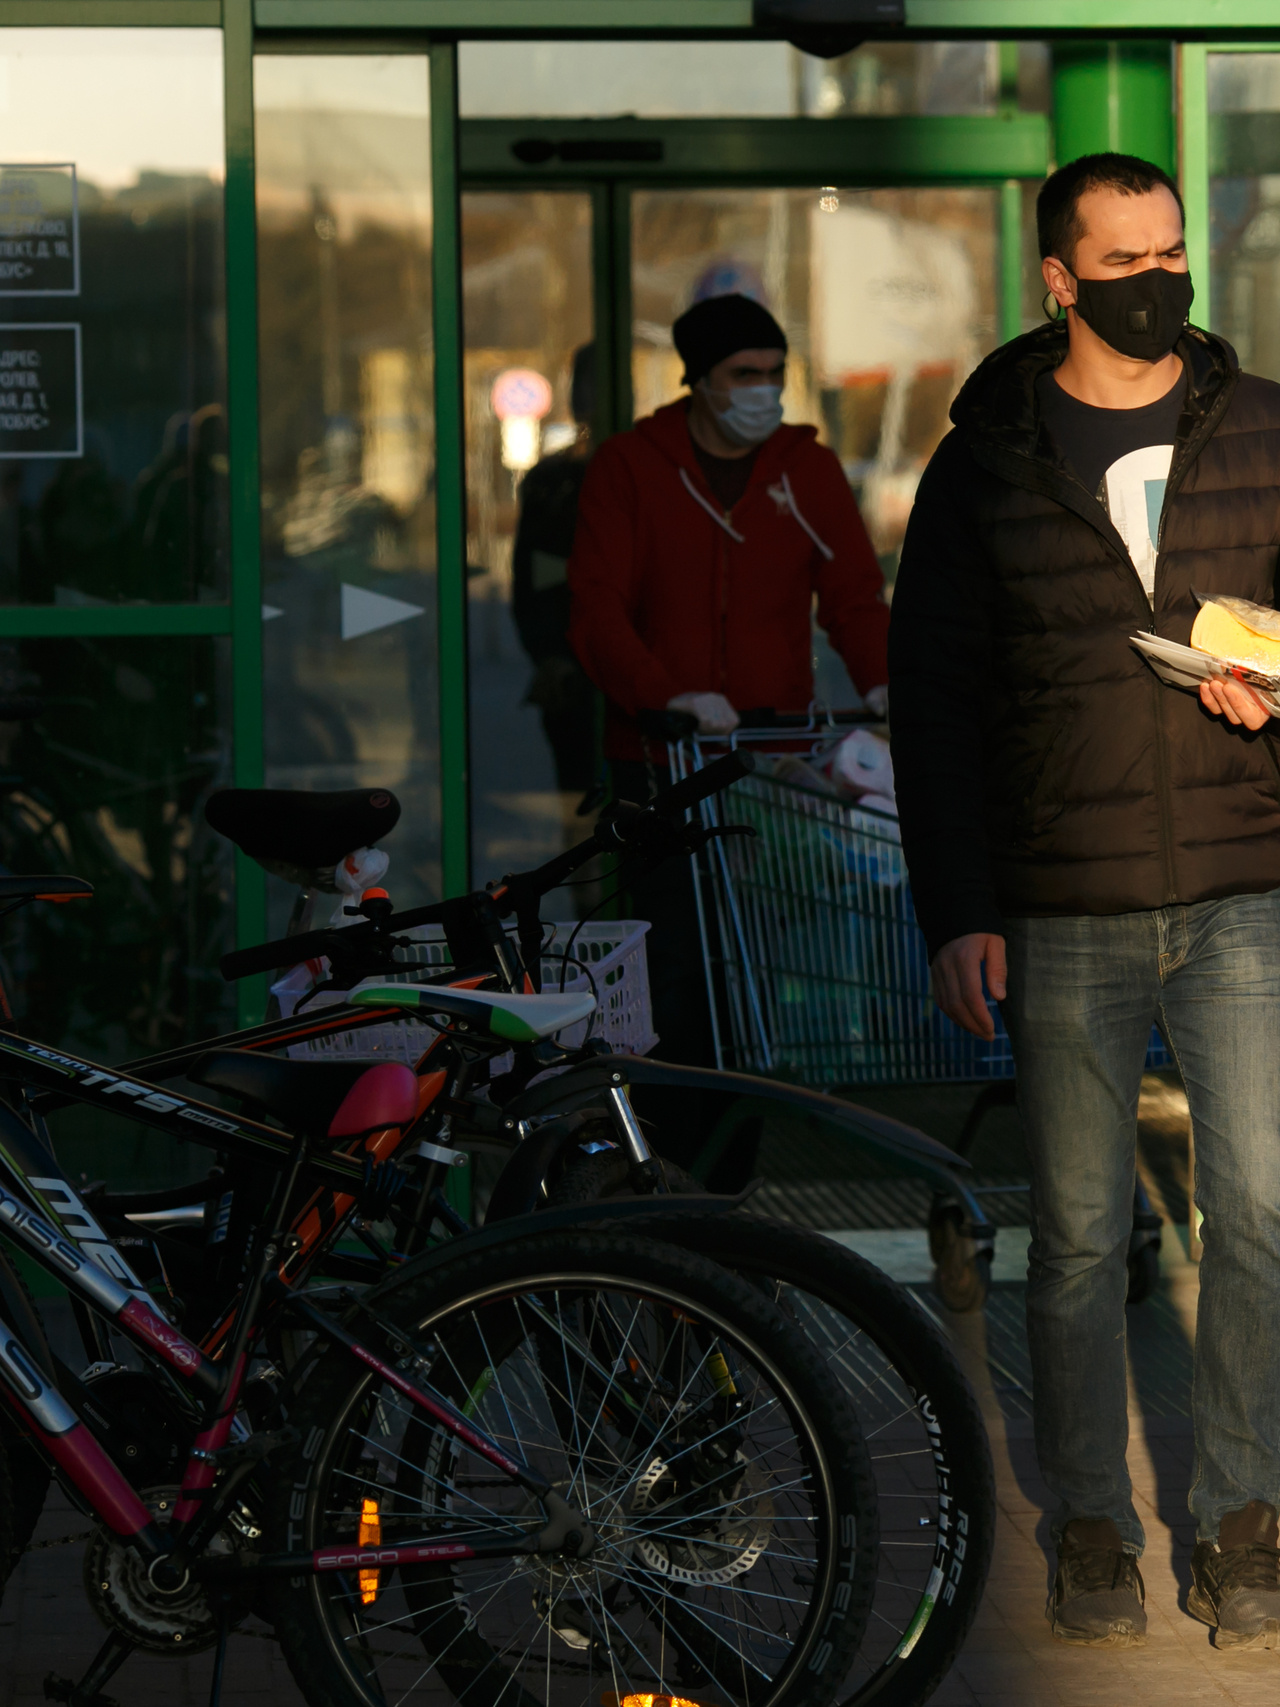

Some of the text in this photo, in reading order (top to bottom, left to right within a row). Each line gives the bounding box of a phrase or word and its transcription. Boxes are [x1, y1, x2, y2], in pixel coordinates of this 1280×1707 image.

[27, 1044, 91, 1073] TEAM
[79, 1069, 188, 1113] TFS
[317, 1544, 467, 1568] 6000 STELS
[808, 1513, 857, 1675] STELS
[942, 1508, 969, 1607] RACE
